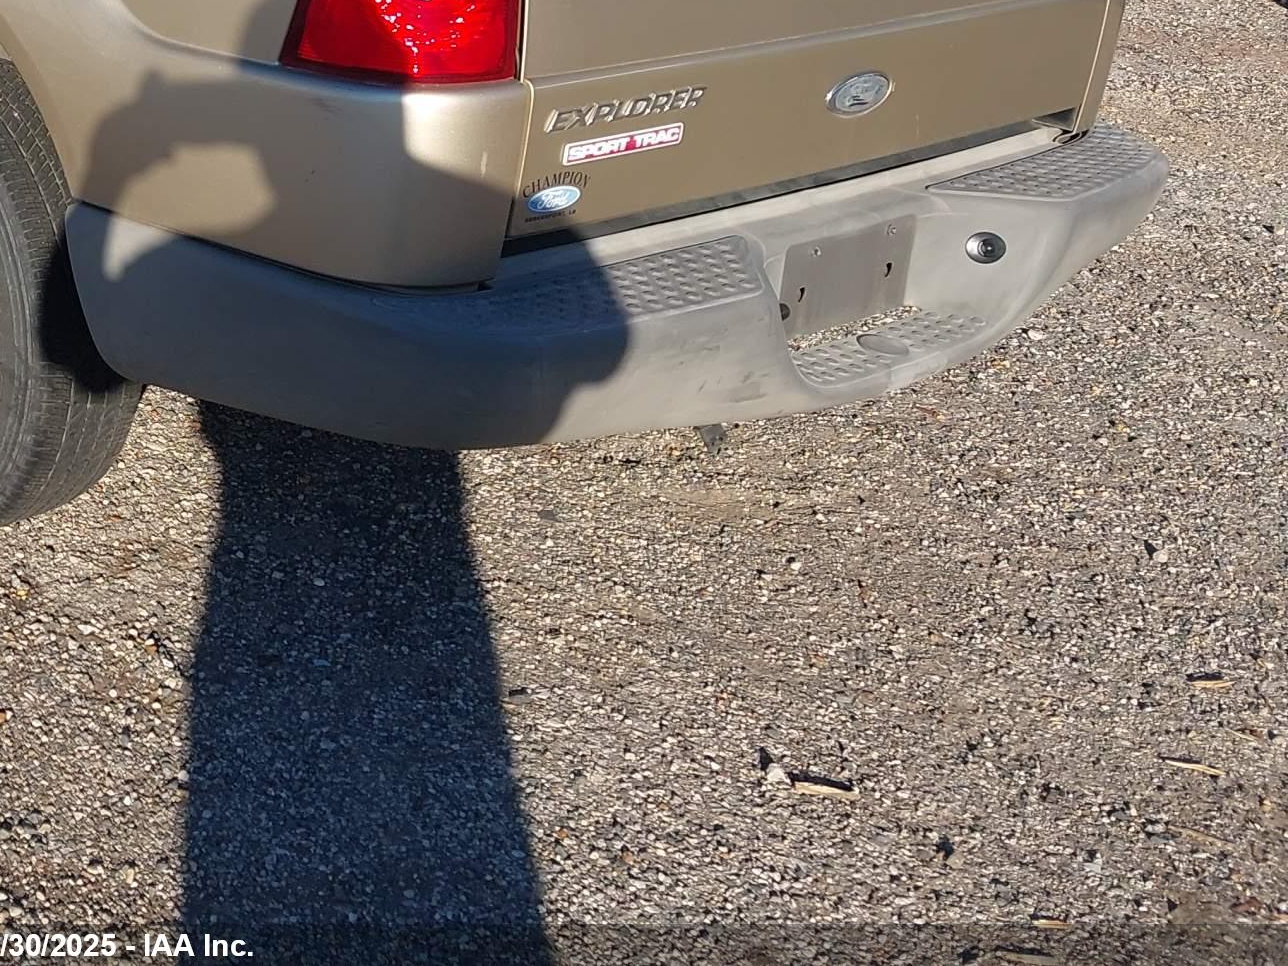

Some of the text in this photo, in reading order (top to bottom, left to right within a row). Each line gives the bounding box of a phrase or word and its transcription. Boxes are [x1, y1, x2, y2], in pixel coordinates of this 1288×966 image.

[543, 86, 707, 133] EXPLORER
[567, 127, 681, 161] SPORT TRAC
[522, 171, 591, 198] CHAMPION
